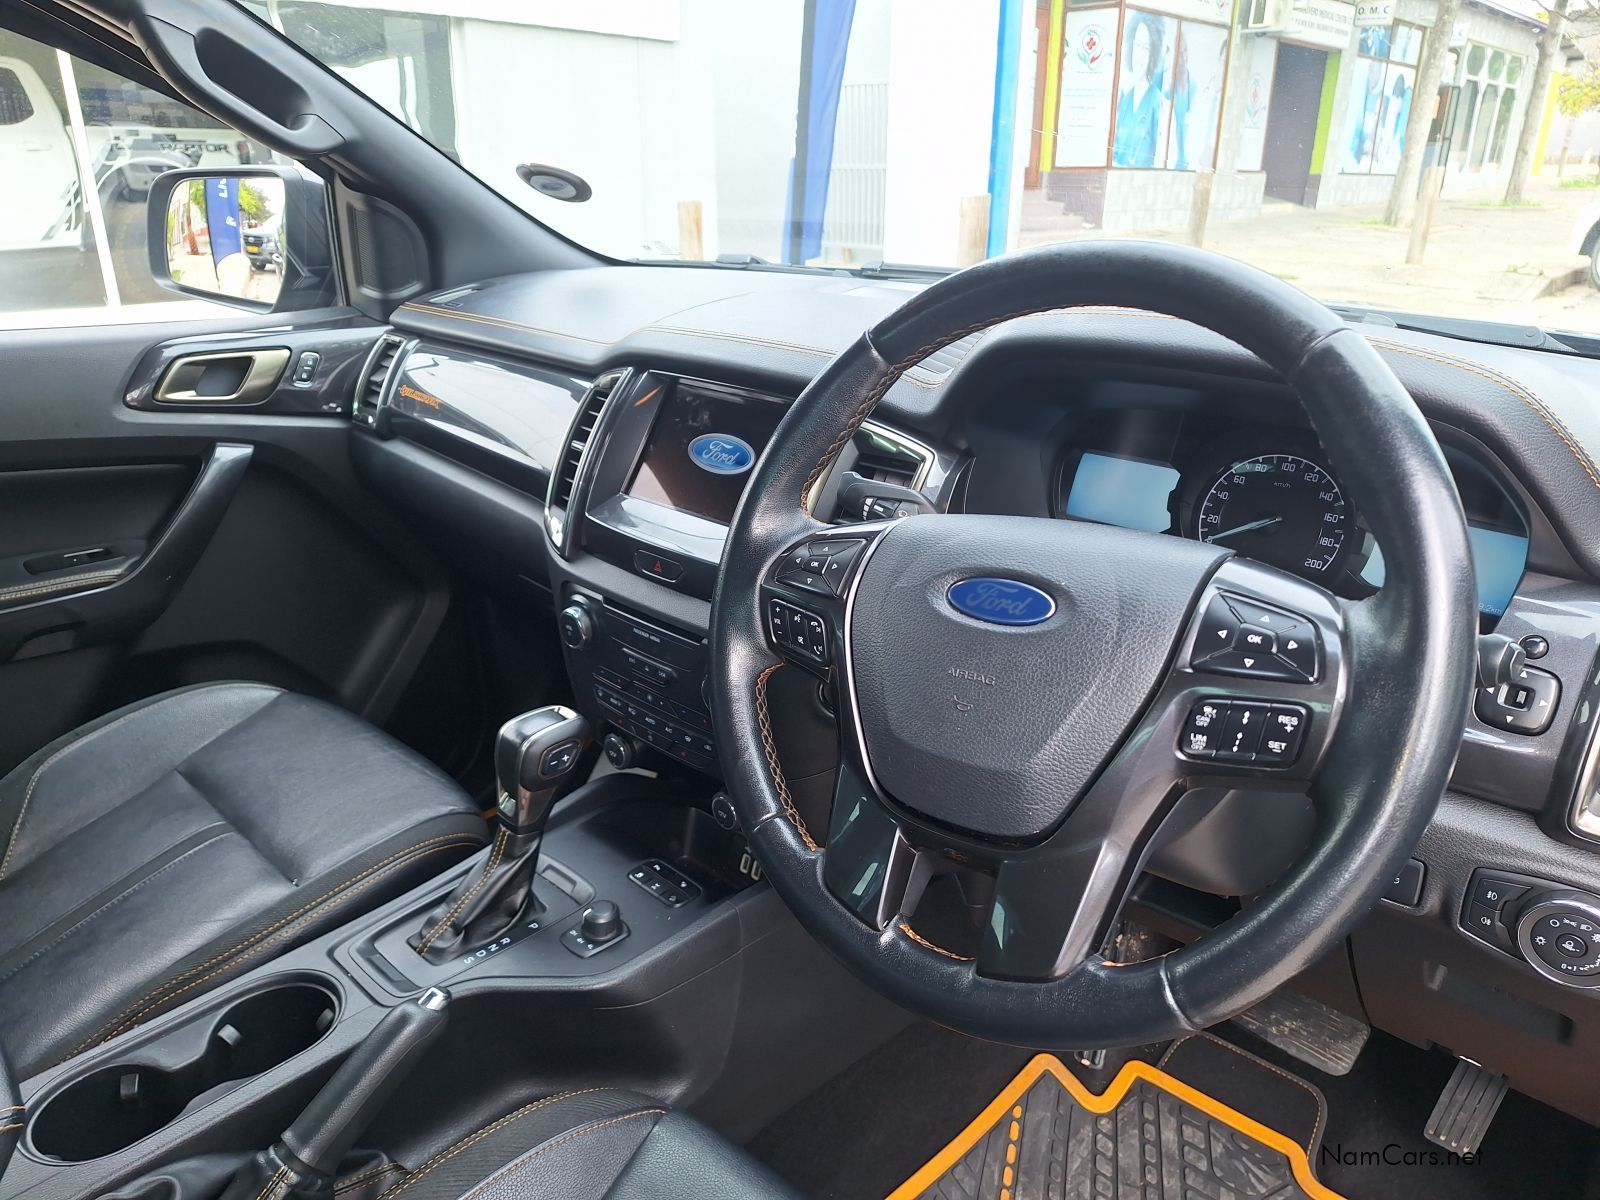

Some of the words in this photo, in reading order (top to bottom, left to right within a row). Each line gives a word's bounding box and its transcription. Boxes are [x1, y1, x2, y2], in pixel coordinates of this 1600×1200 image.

[702, 440, 739, 465] Ford
[1255, 464, 1267, 472] 80
[1281, 462, 1296, 472] 100
[1233, 475, 1245, 485] 60
[1304, 473, 1319, 482] 120
[1217, 491, 1229, 500] 40
[1319, 491, 1334, 501] 140
[1207, 514, 1218, 524] 20
[1323, 512, 1339, 522] 160
[1320, 537, 1334, 547] 180
[810, 560, 820, 568] OK
[1304, 558, 1323, 569] 200
[966, 582, 1033, 615] Ford
[1247, 634, 1263, 645] OK
[946, 667, 996, 686] AIRBAG
[1278, 715, 1299, 726] RES
[1190, 733, 1208, 741] LIM
[1267, 740, 1288, 750] SET
[500, 937, 511, 945] R
[487, 943, 500, 952] N
[475, 949, 487, 957] D
[463, 956, 475, 964] S
